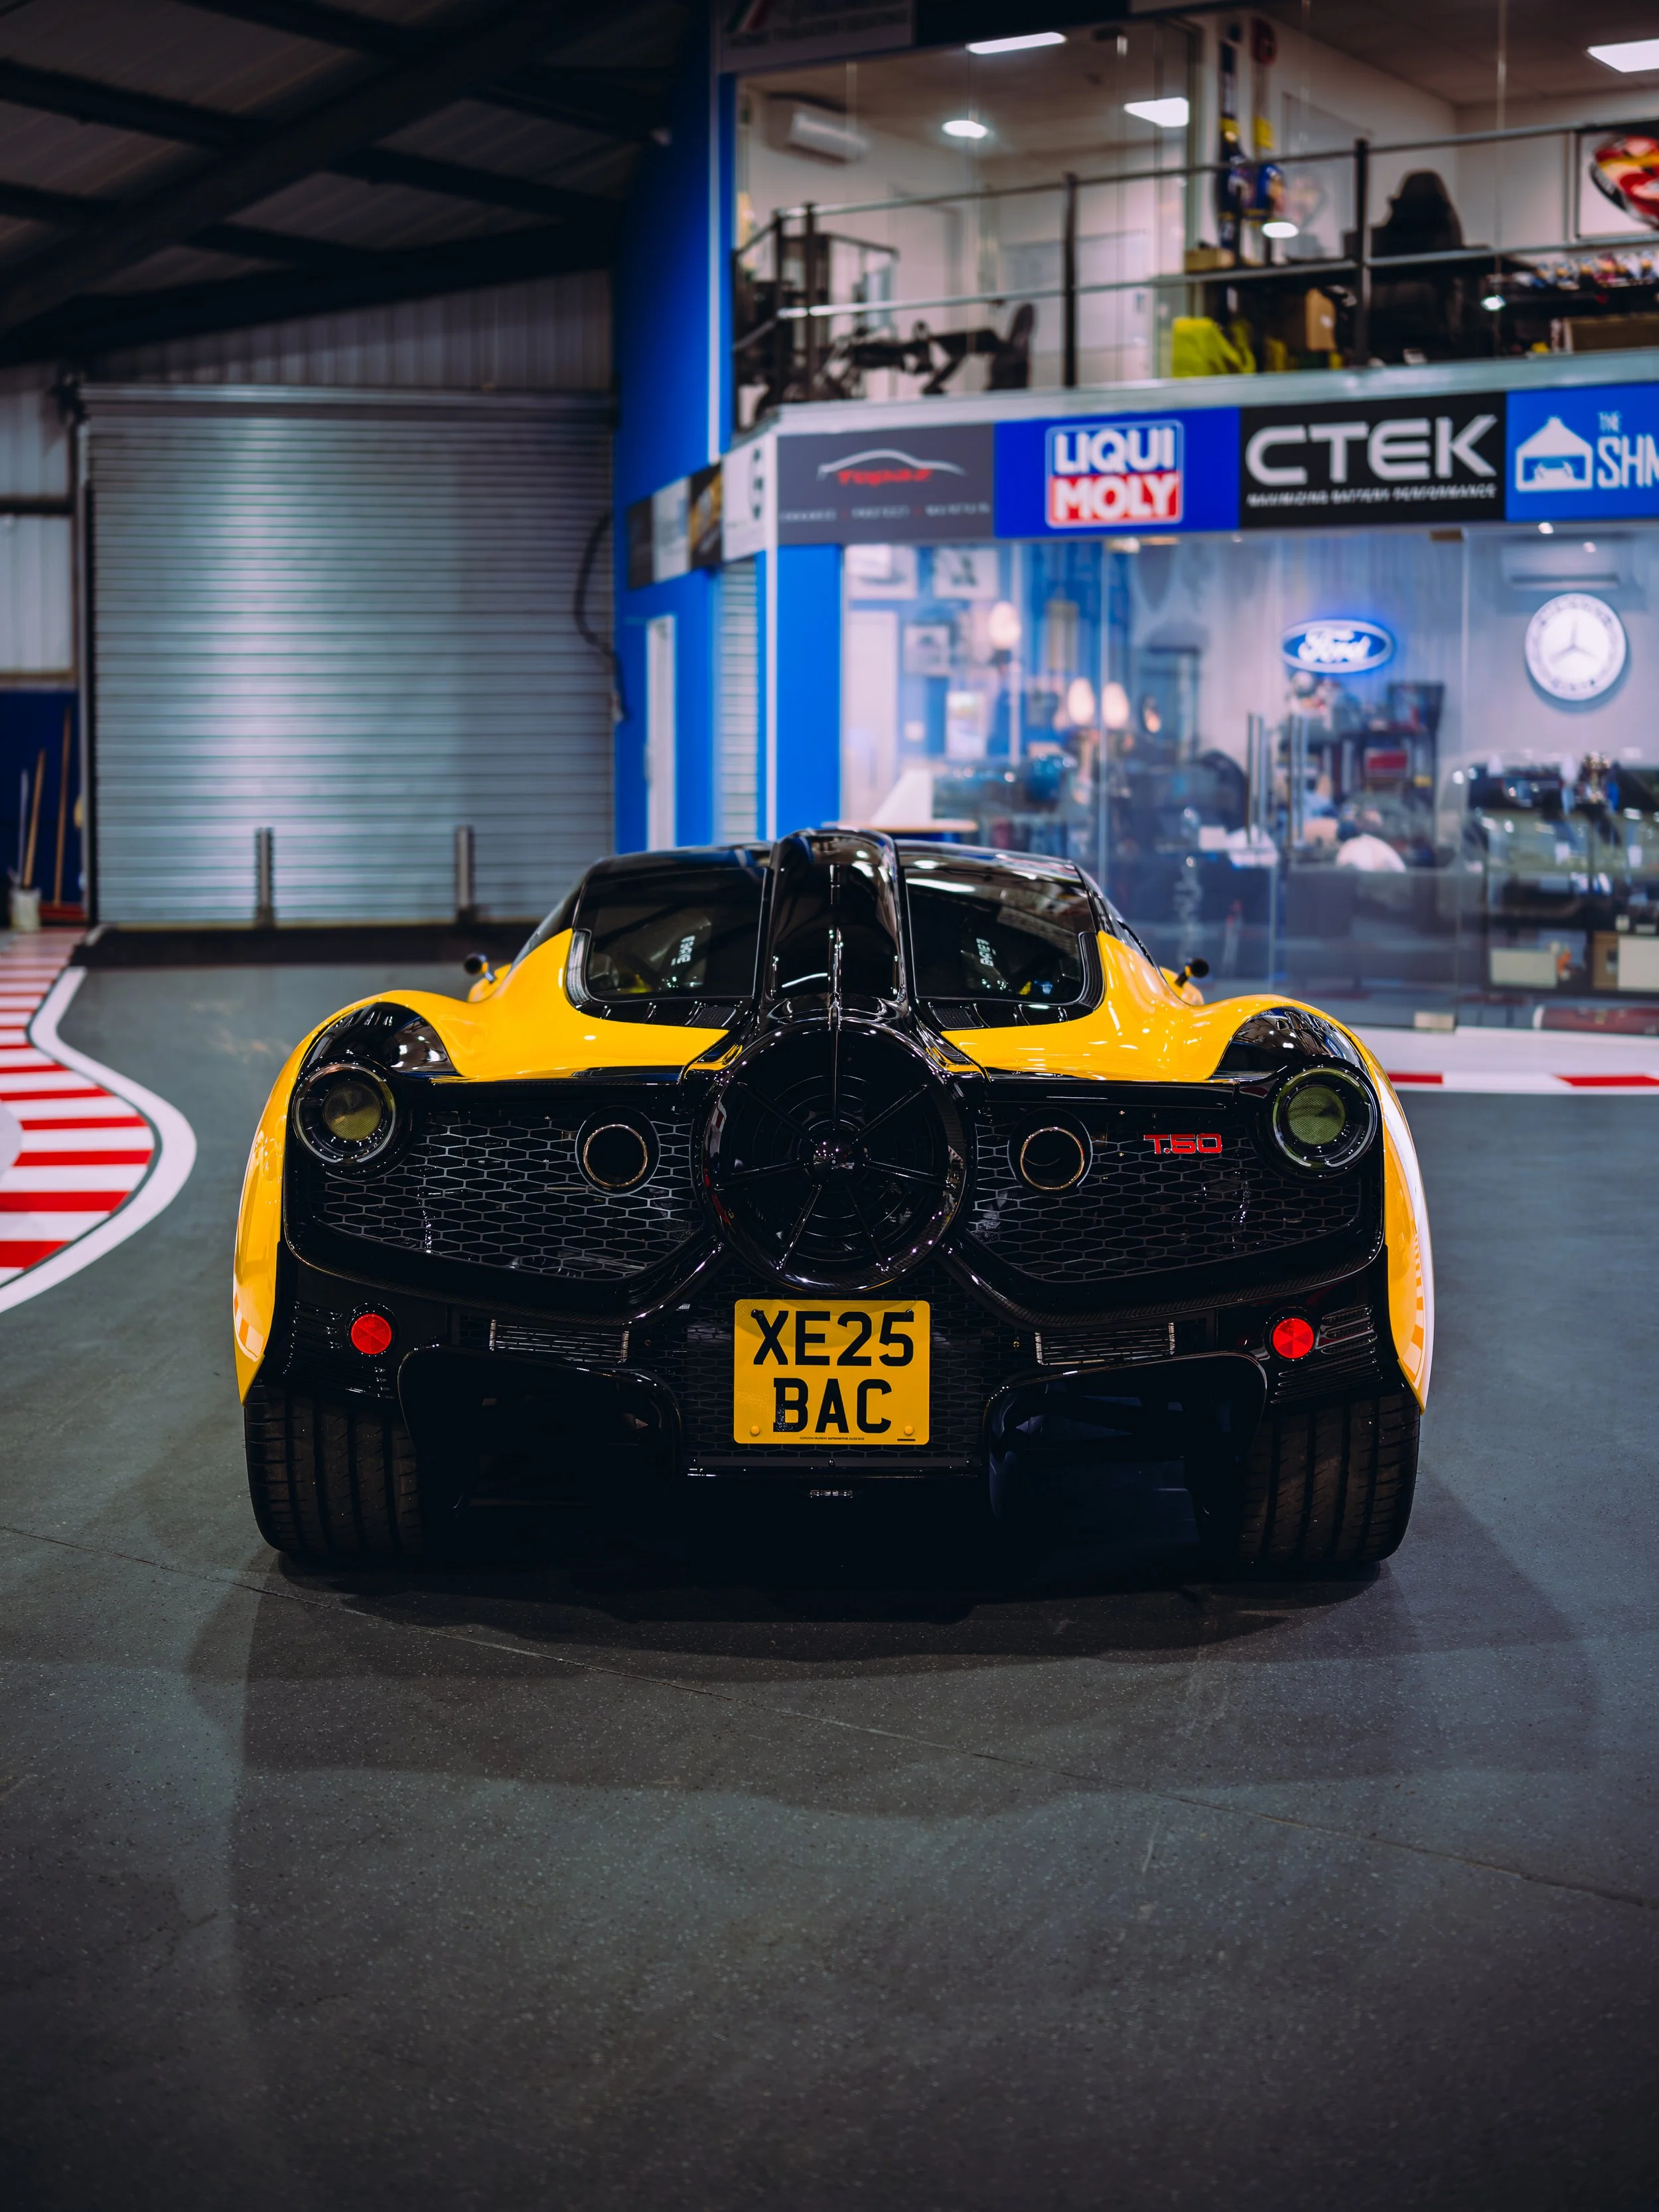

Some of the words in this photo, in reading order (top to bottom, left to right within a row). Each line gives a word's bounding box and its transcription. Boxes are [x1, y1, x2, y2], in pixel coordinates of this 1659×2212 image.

[1055, 428, 1175, 474] LIQUI
[1246, 414, 1498, 486] CTEK
[1054, 472, 1177, 520] MOLY
[1330, 487, 1390, 504] BATTERY
[1392, 482, 1497, 502] PERFORMANCE
[1143, 1133, 1222, 1155] T.50
[753, 1310, 914, 1367] XE25
[773, 1377, 893, 1434] BAC
